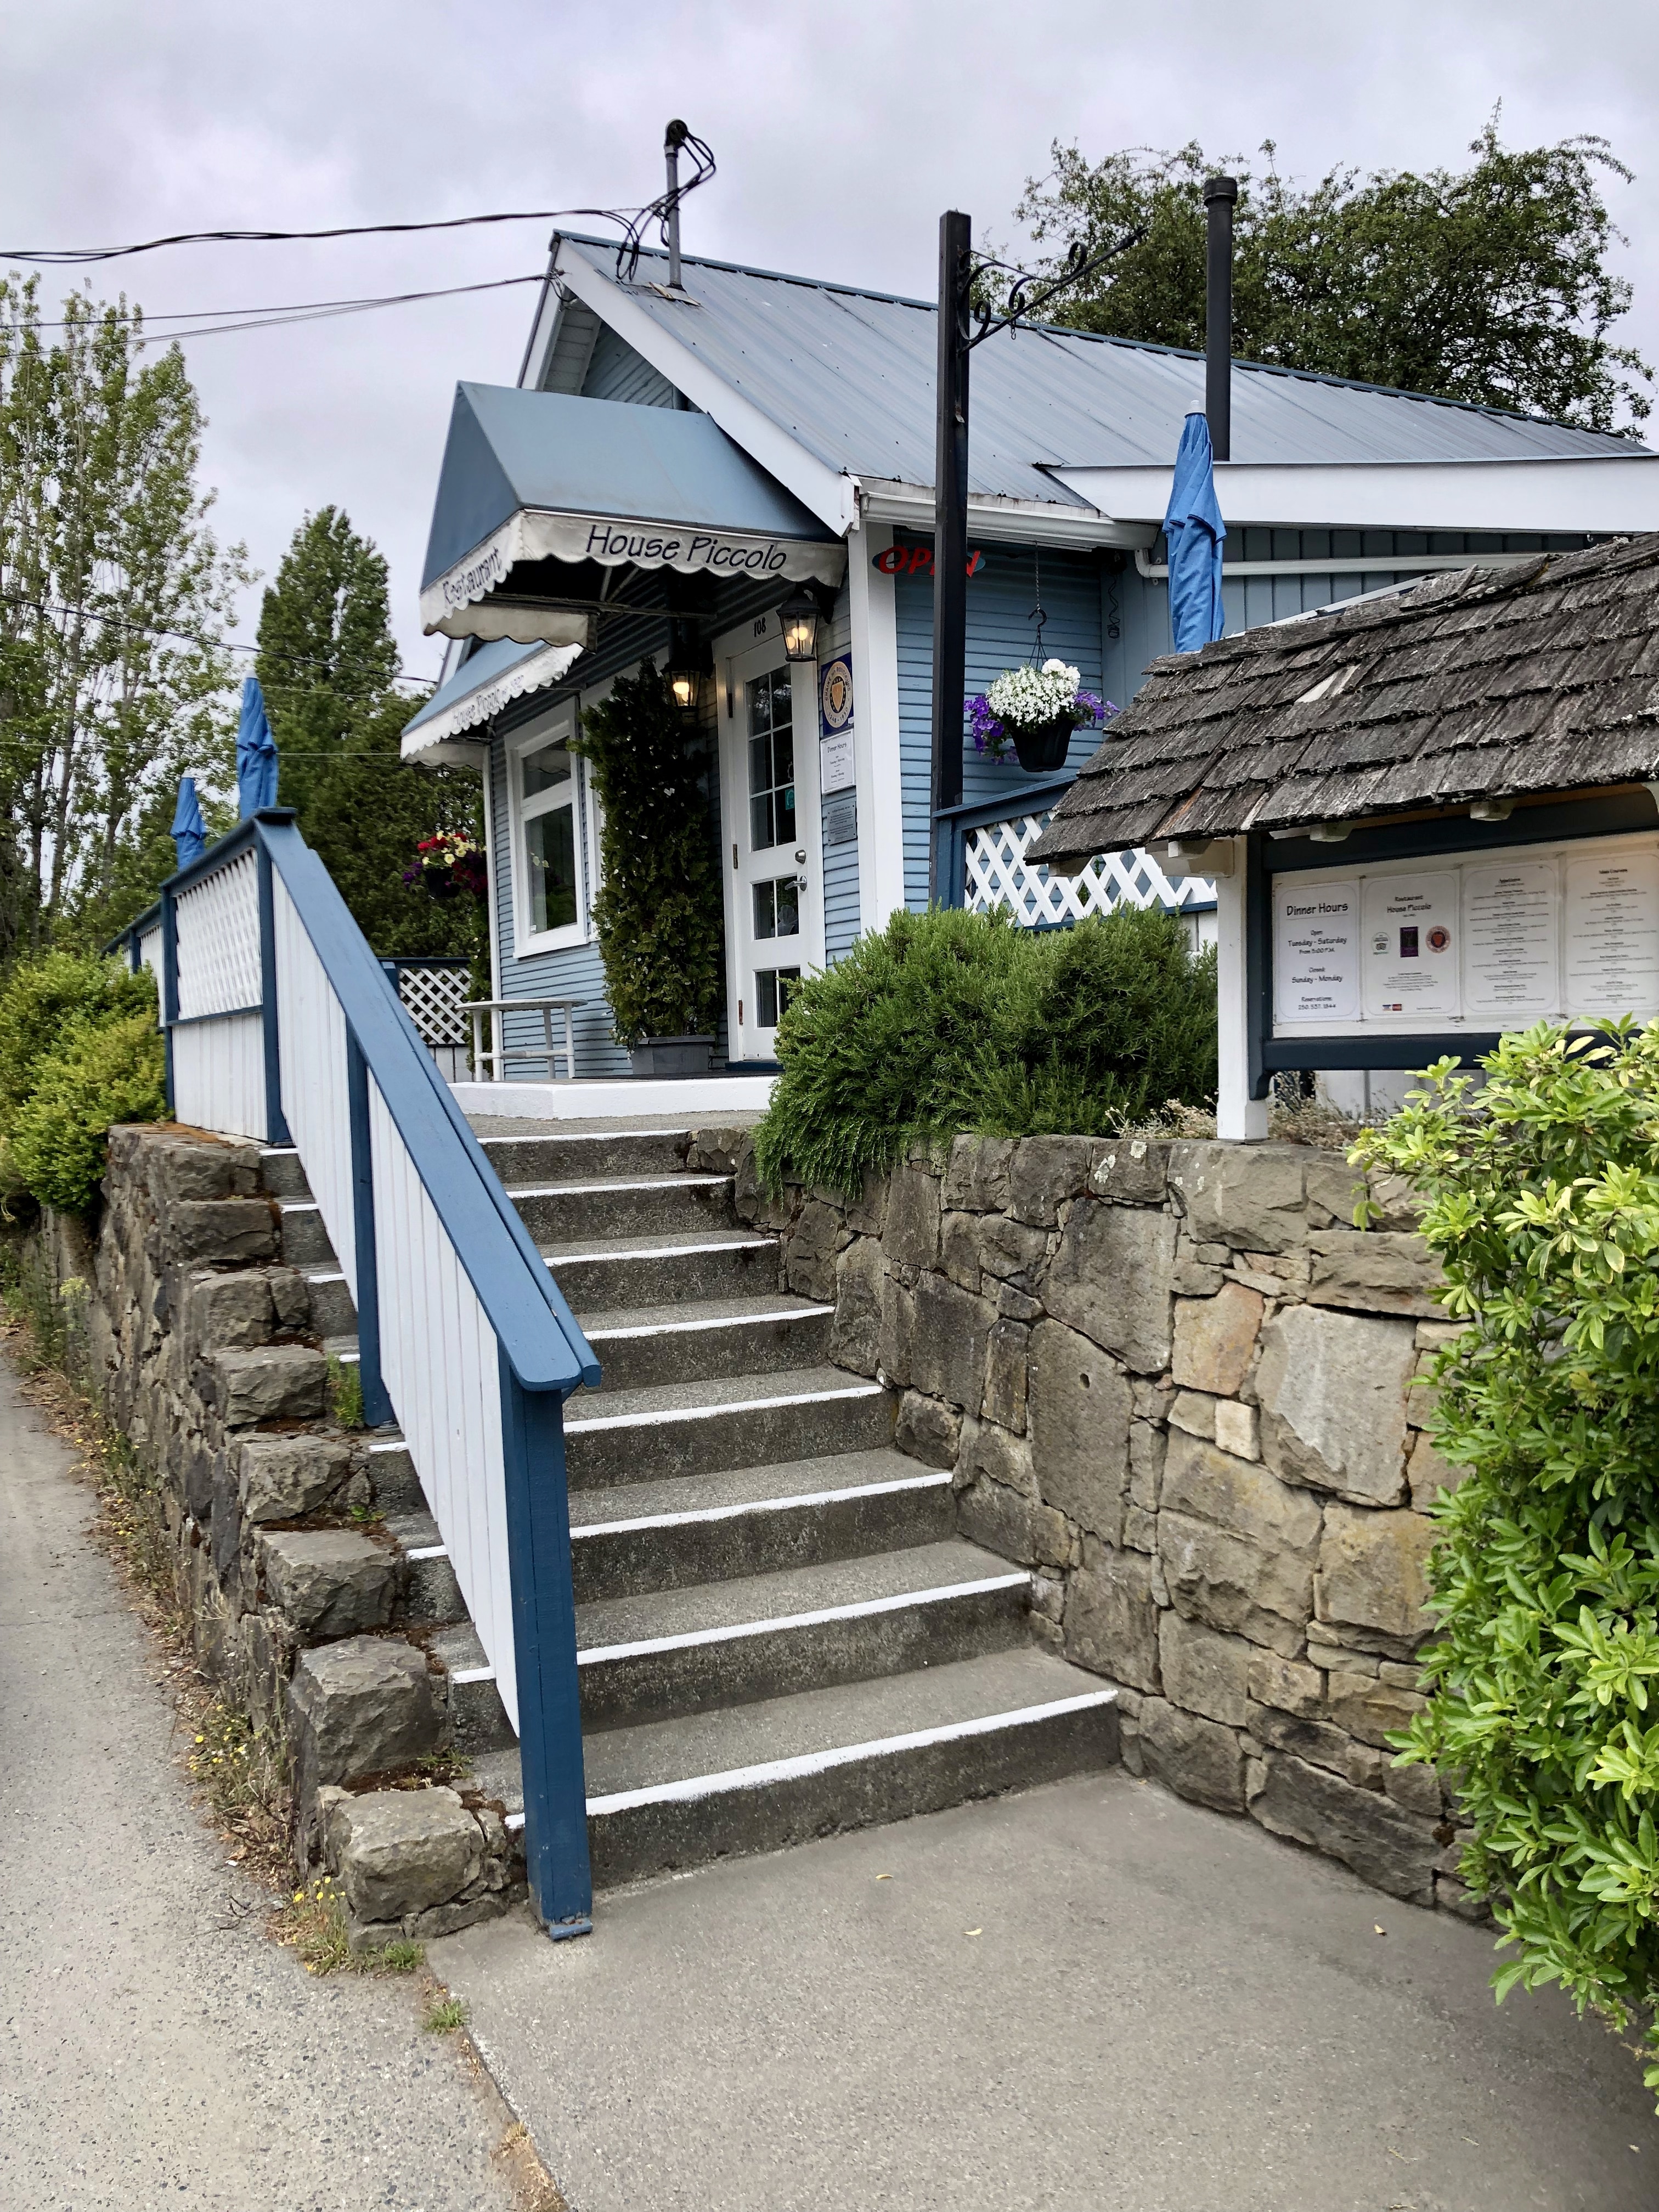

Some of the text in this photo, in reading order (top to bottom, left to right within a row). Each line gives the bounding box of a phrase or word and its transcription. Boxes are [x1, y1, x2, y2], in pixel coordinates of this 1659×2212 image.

[585, 524, 787, 570] House Piccolo
[443, 546, 501, 610] Restaurant
[754, 617, 766, 637] 108
[1286, 902, 1348, 916] Dinner Hours
[1387, 903, 1432, 913] House Piccolo
[1291, 976, 1313, 984] Sunday
[1318, 974, 1344, 983] Monday
